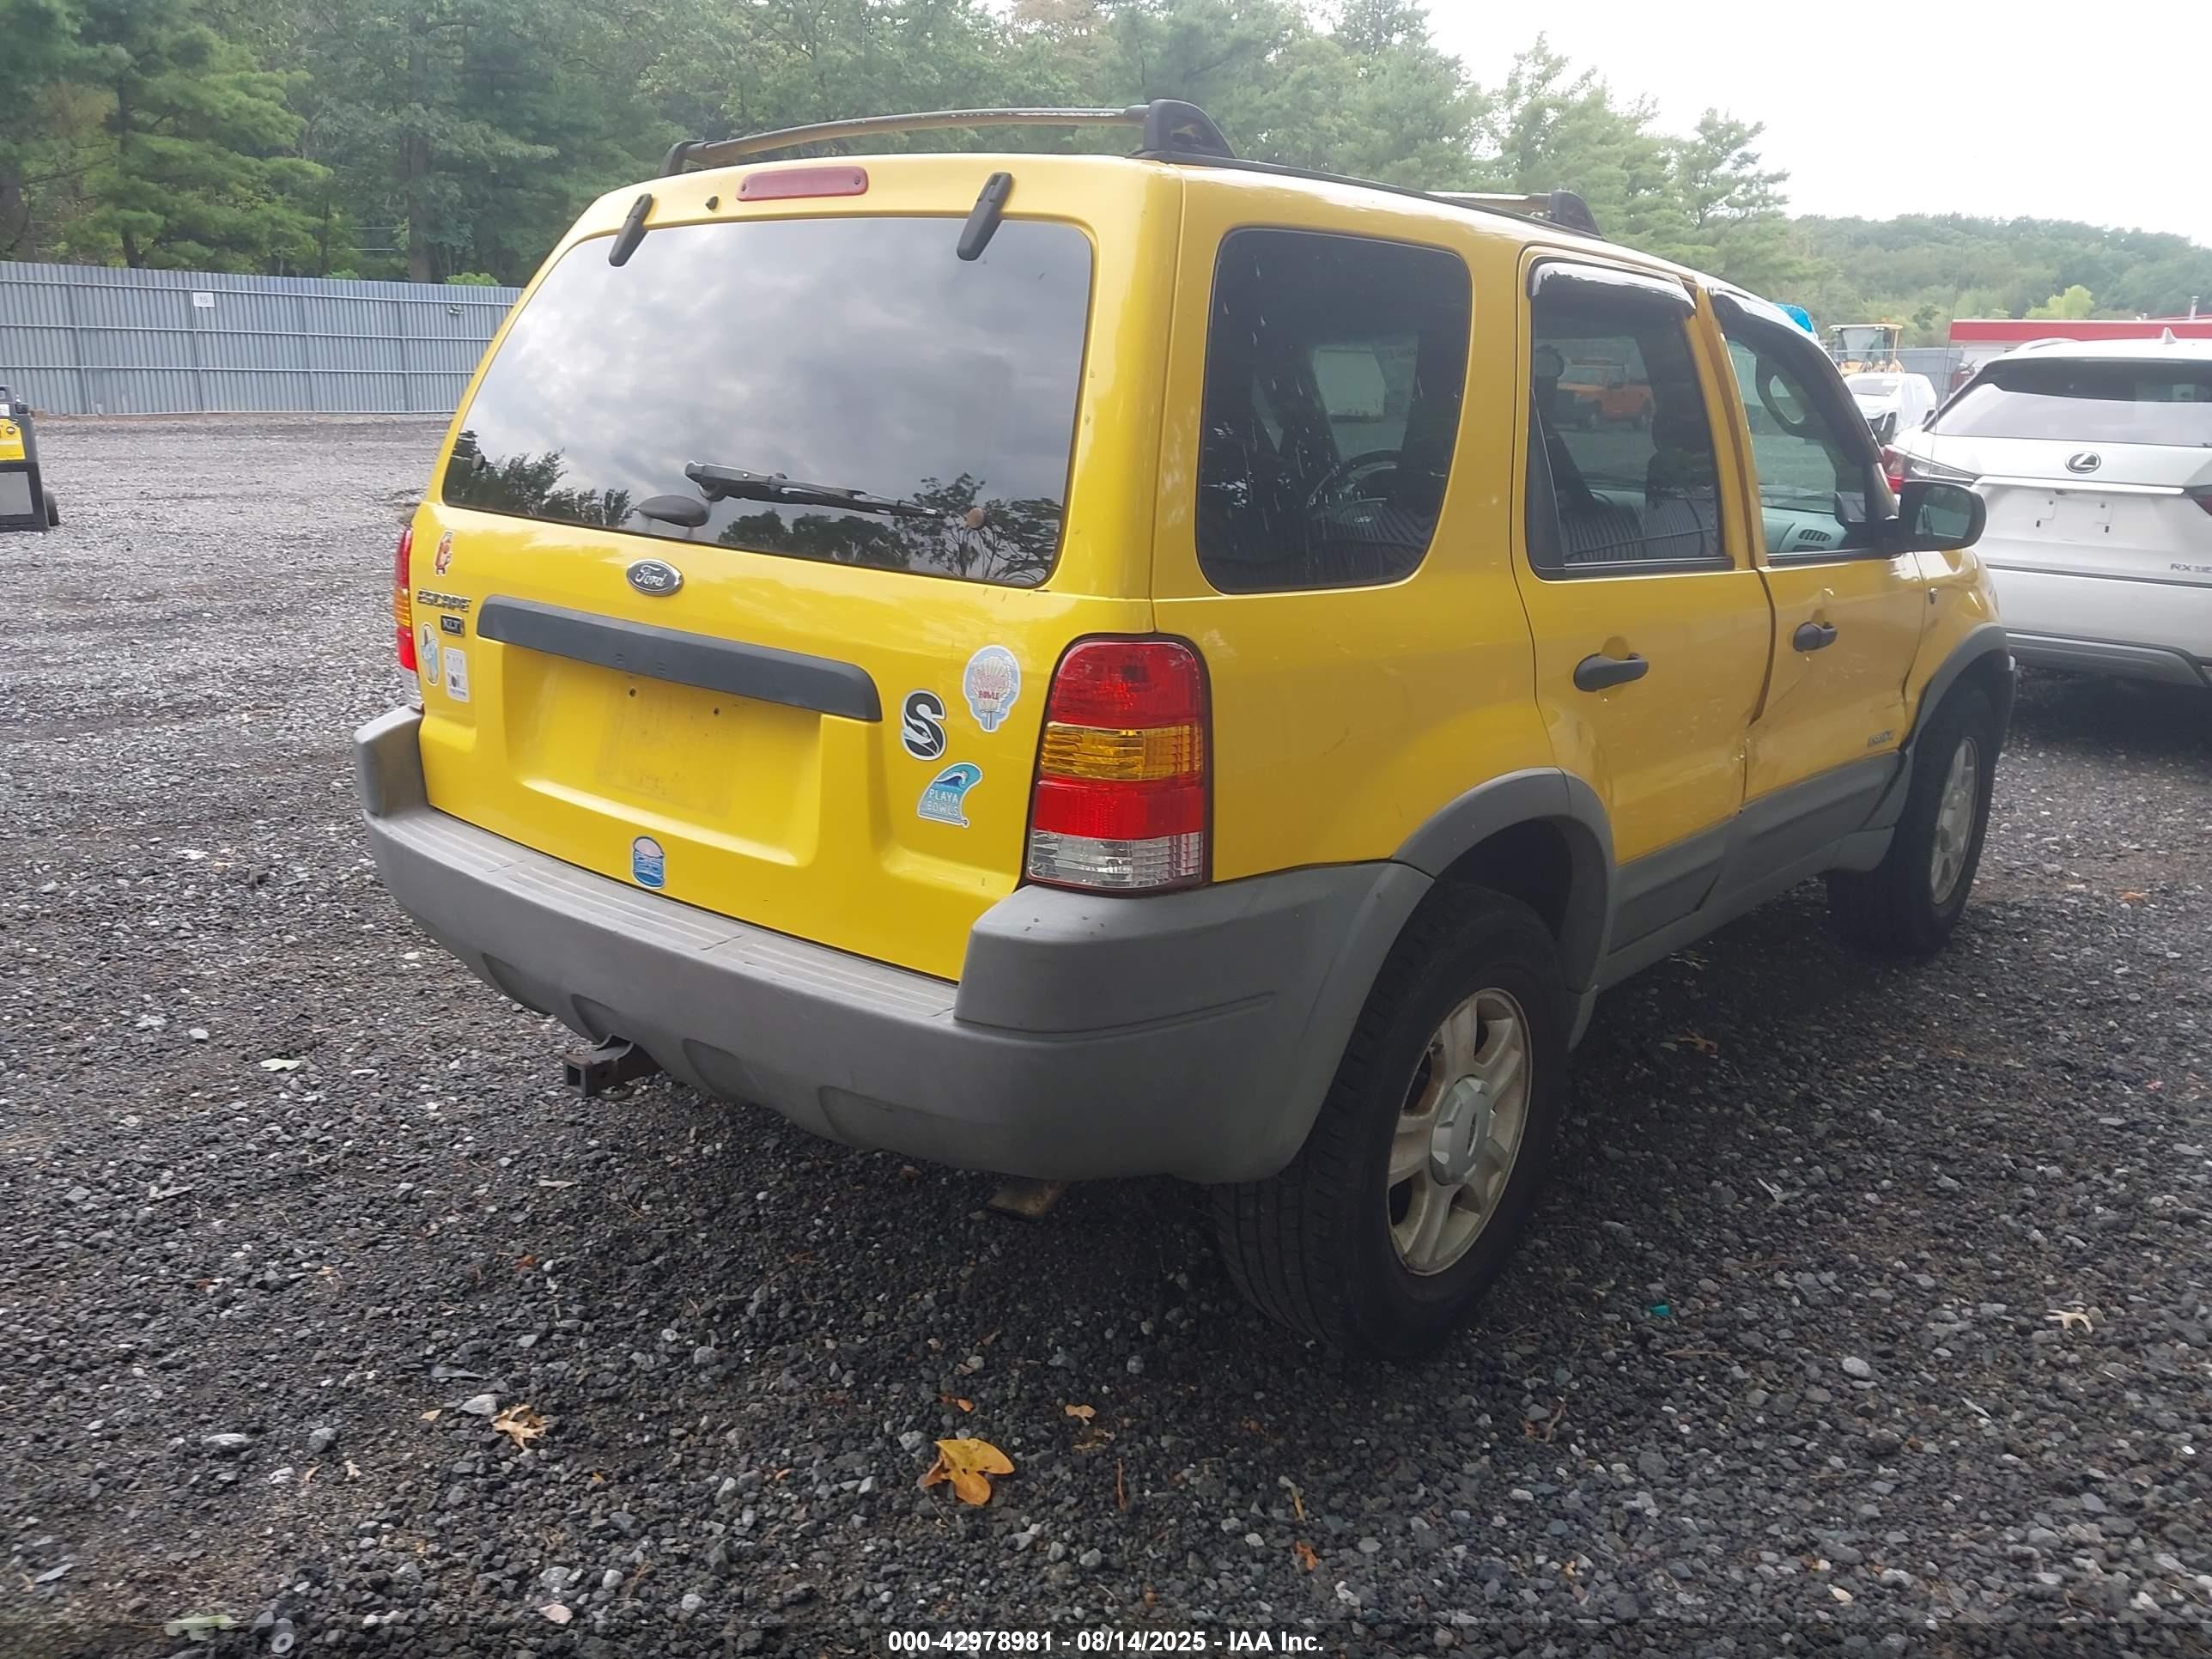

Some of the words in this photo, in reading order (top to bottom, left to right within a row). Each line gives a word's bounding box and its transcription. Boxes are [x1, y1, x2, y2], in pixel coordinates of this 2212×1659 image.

[635, 564, 666, 587] Ford
[2170, 562, 2192, 572] RX
[417, 588, 472, 613] ESCAPE
[927, 788, 959, 805] PLAYA
[927, 799, 959, 817] BOWLS
